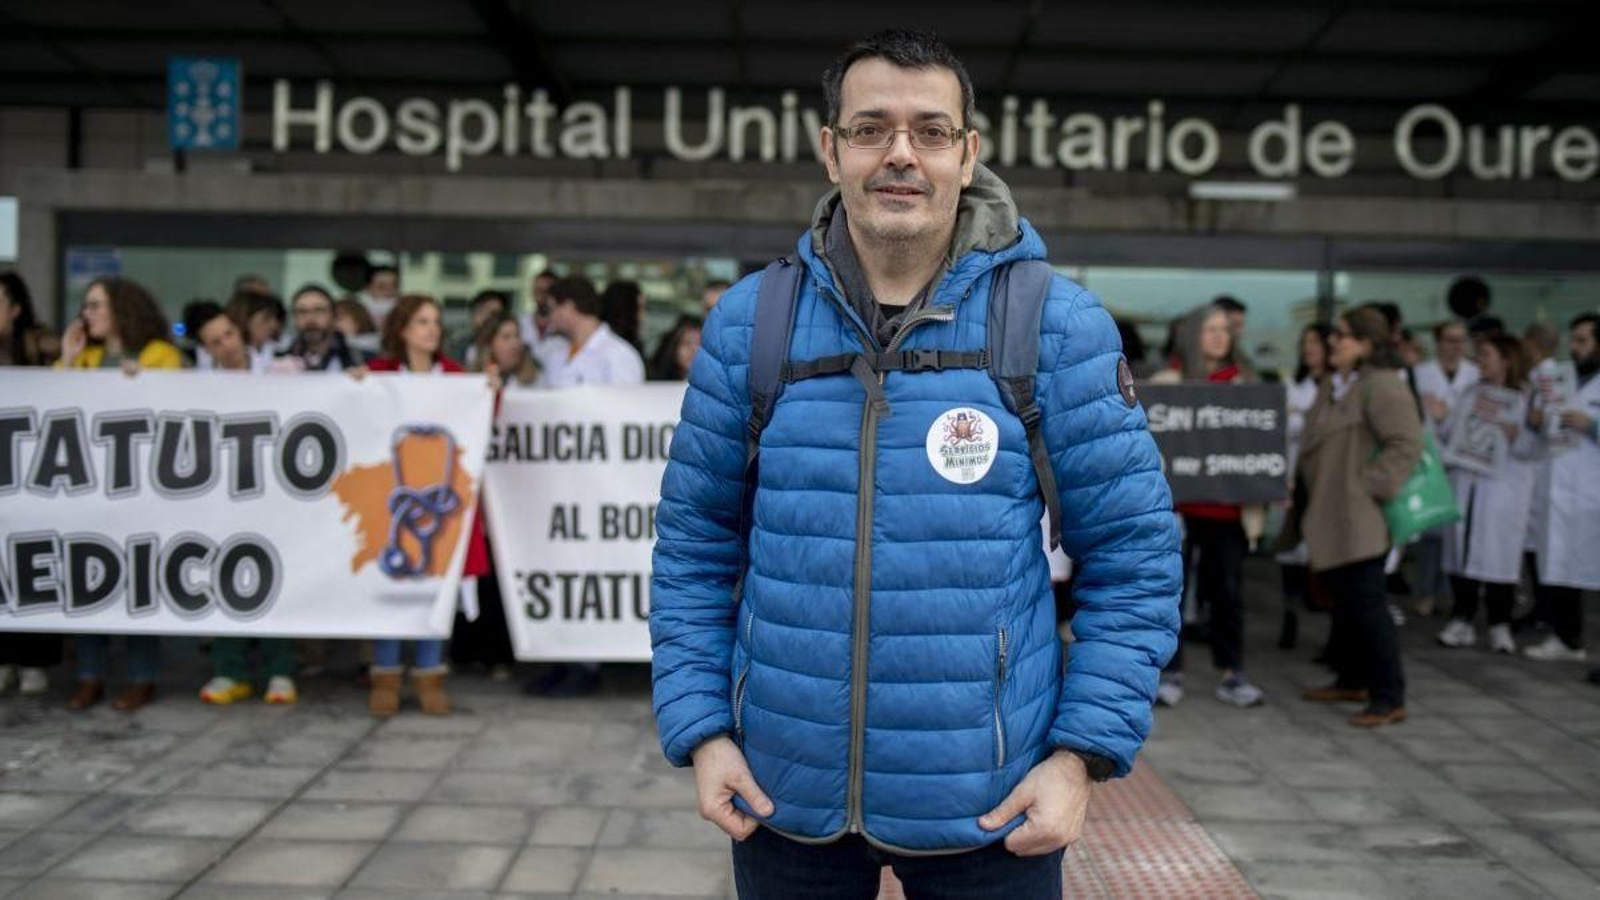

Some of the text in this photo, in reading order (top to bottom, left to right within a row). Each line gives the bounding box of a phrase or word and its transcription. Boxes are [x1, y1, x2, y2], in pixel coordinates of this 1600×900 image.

[272, 78, 631, 172] Hospital
[663, 86, 1219, 176] Univsitario
[1248, 103, 1356, 179] de
[549, 504, 588, 541] AL
[0, 529, 283, 620] EDICO
[516, 571, 650, 621] STATU
